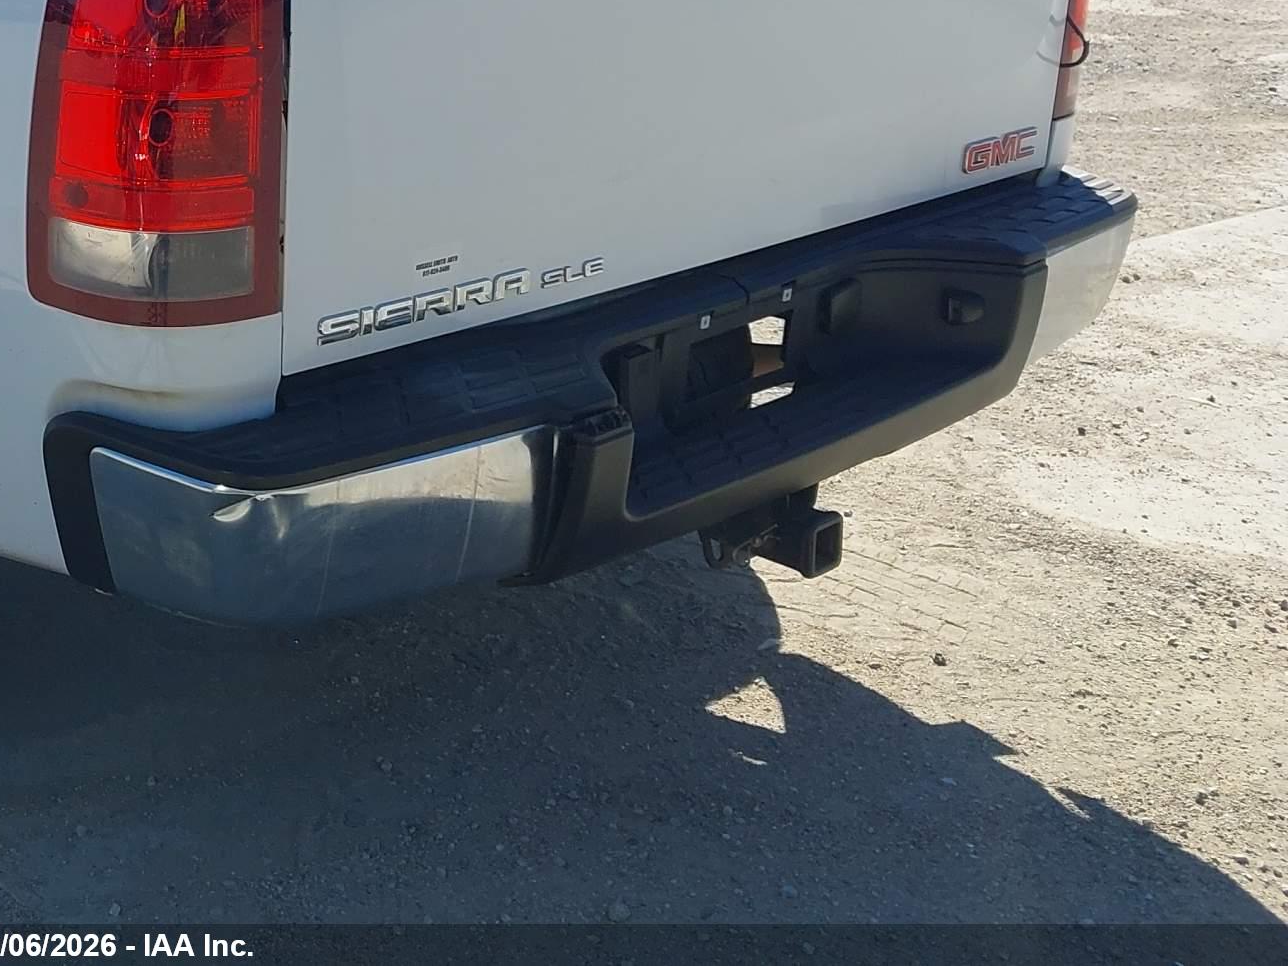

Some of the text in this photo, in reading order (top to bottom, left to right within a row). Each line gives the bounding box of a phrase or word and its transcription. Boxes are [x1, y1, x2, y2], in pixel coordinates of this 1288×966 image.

[962, 126, 1038, 174] GMC
[317, 257, 605, 346] SIERRA SLE
